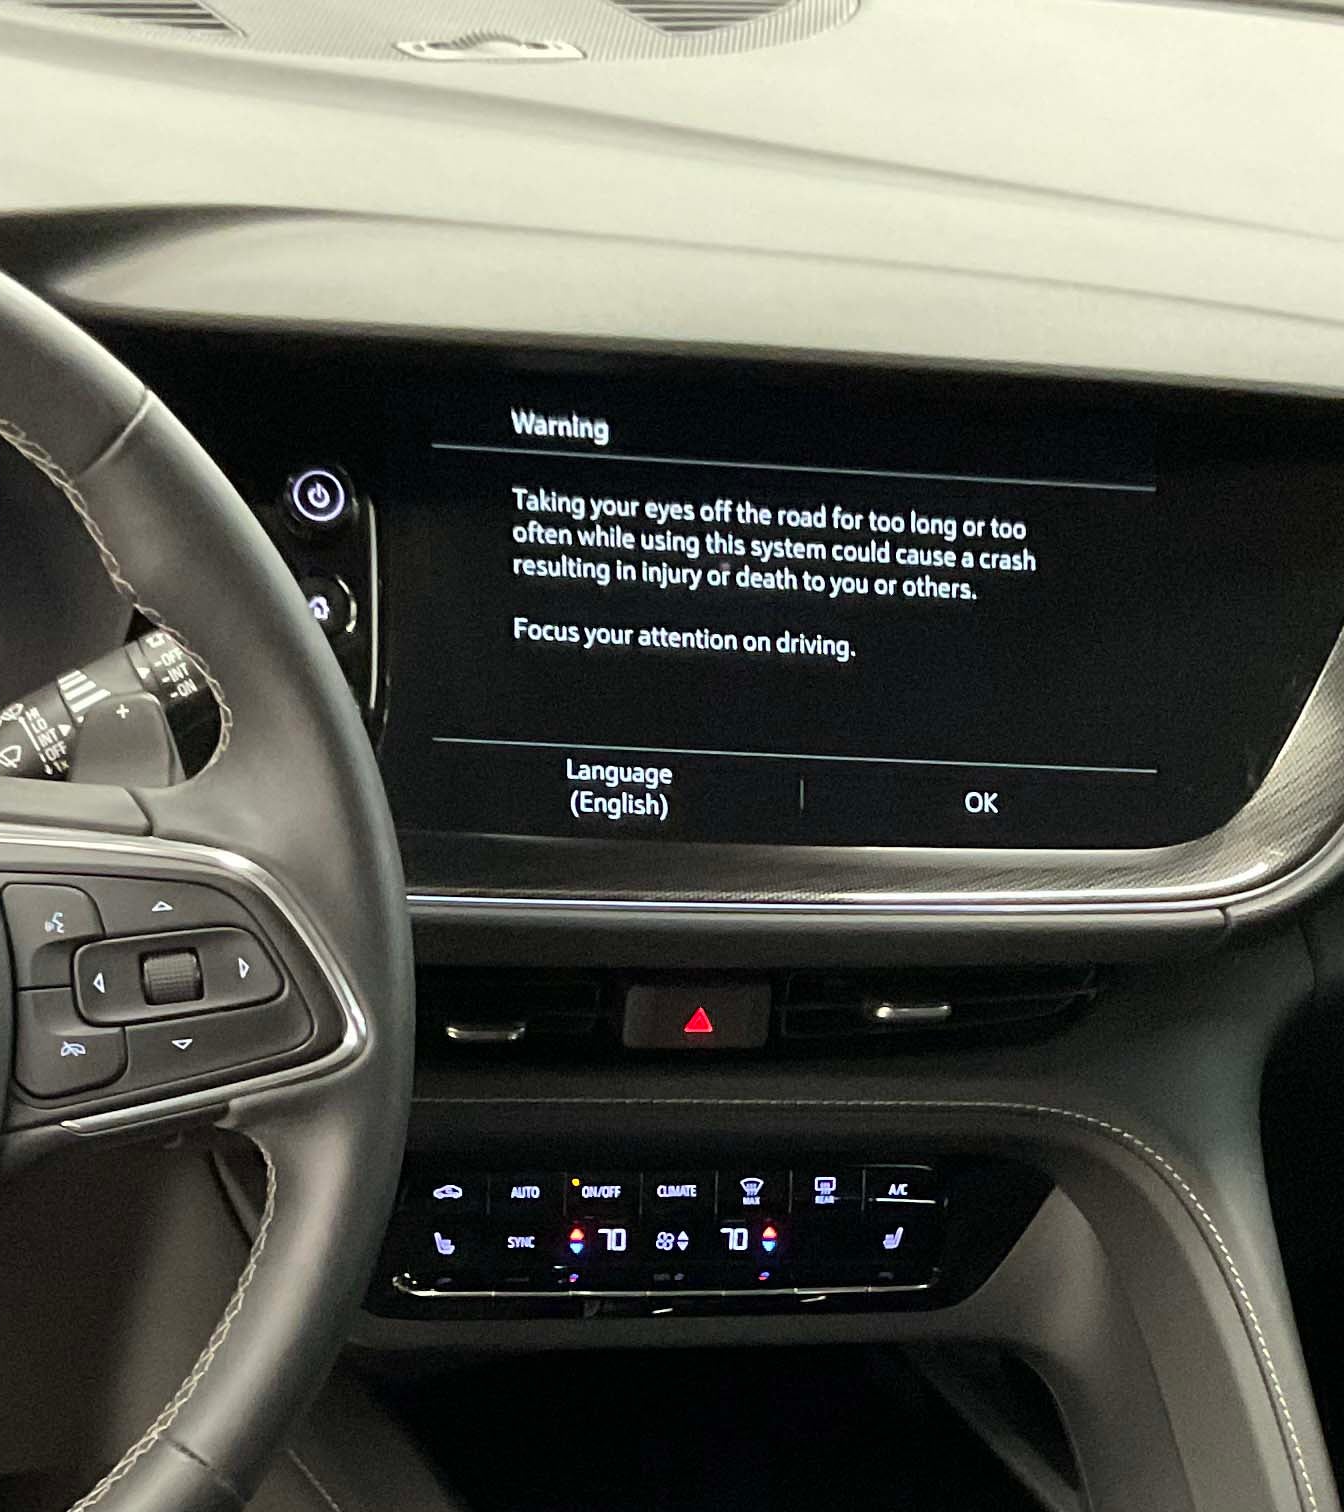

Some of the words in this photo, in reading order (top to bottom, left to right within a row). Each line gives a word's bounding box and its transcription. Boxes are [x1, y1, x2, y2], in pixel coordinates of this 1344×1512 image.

[510, 407, 609, 446] Warning
[511, 486, 586, 520] Taking
[589, 498, 640, 521] your
[644, 500, 693, 525] eyes
[699, 499, 732, 523] off
[735, 501, 772, 526] the
[777, 503, 826, 529] road
[832, 505, 864, 530] for
[868, 511, 905, 533] too
[910, 509, 957, 543] long
[962, 518, 986, 538] or
[990, 518, 1027, 540] too
[512, 520, 573, 546] often
[578, 524, 635, 549] while
[640, 530, 700, 559] using
[704, 531, 746, 556] this
[750, 537, 826, 563] system
[832, 539, 890, 564] could
[895, 549, 956, 568] cause
[961, 552, 974, 568] a
[979, 547, 1036, 572] crash
[512, 554, 611, 586] resulting
[616, 561, 637, 581] in
[641, 561, 703, 590] injury
[706, 569, 730, 587] or
[735, 564, 797, 591] death
[802, 570, 826, 592] to
[829, 576, 868, 598] you
[874, 577, 897, 596] or
[902, 574, 977, 601] others.
[513, 617, 580, 643] Focus
[584, 625, 634, 649] your
[638, 626, 738, 651] attention
[743, 634, 771, 652] on
[776, 630, 857, 662] driving.
[45, 741, 67, 761] OFF
[565, 758, 673, 790] Language
[570, 790, 669, 821] (English)
[964, 791, 998, 815] OK
[511, 1186, 540, 1199] AUTO
[582, 1185, 621, 1199] ON/OFF
[657, 1184, 697, 1198] CLIMATE
[888, 1183, 908, 1196] A/C
[507, 1236, 535, 1249] SYNC
[597, 1228, 627, 1252] 70
[720, 1227, 749, 1251] 70
